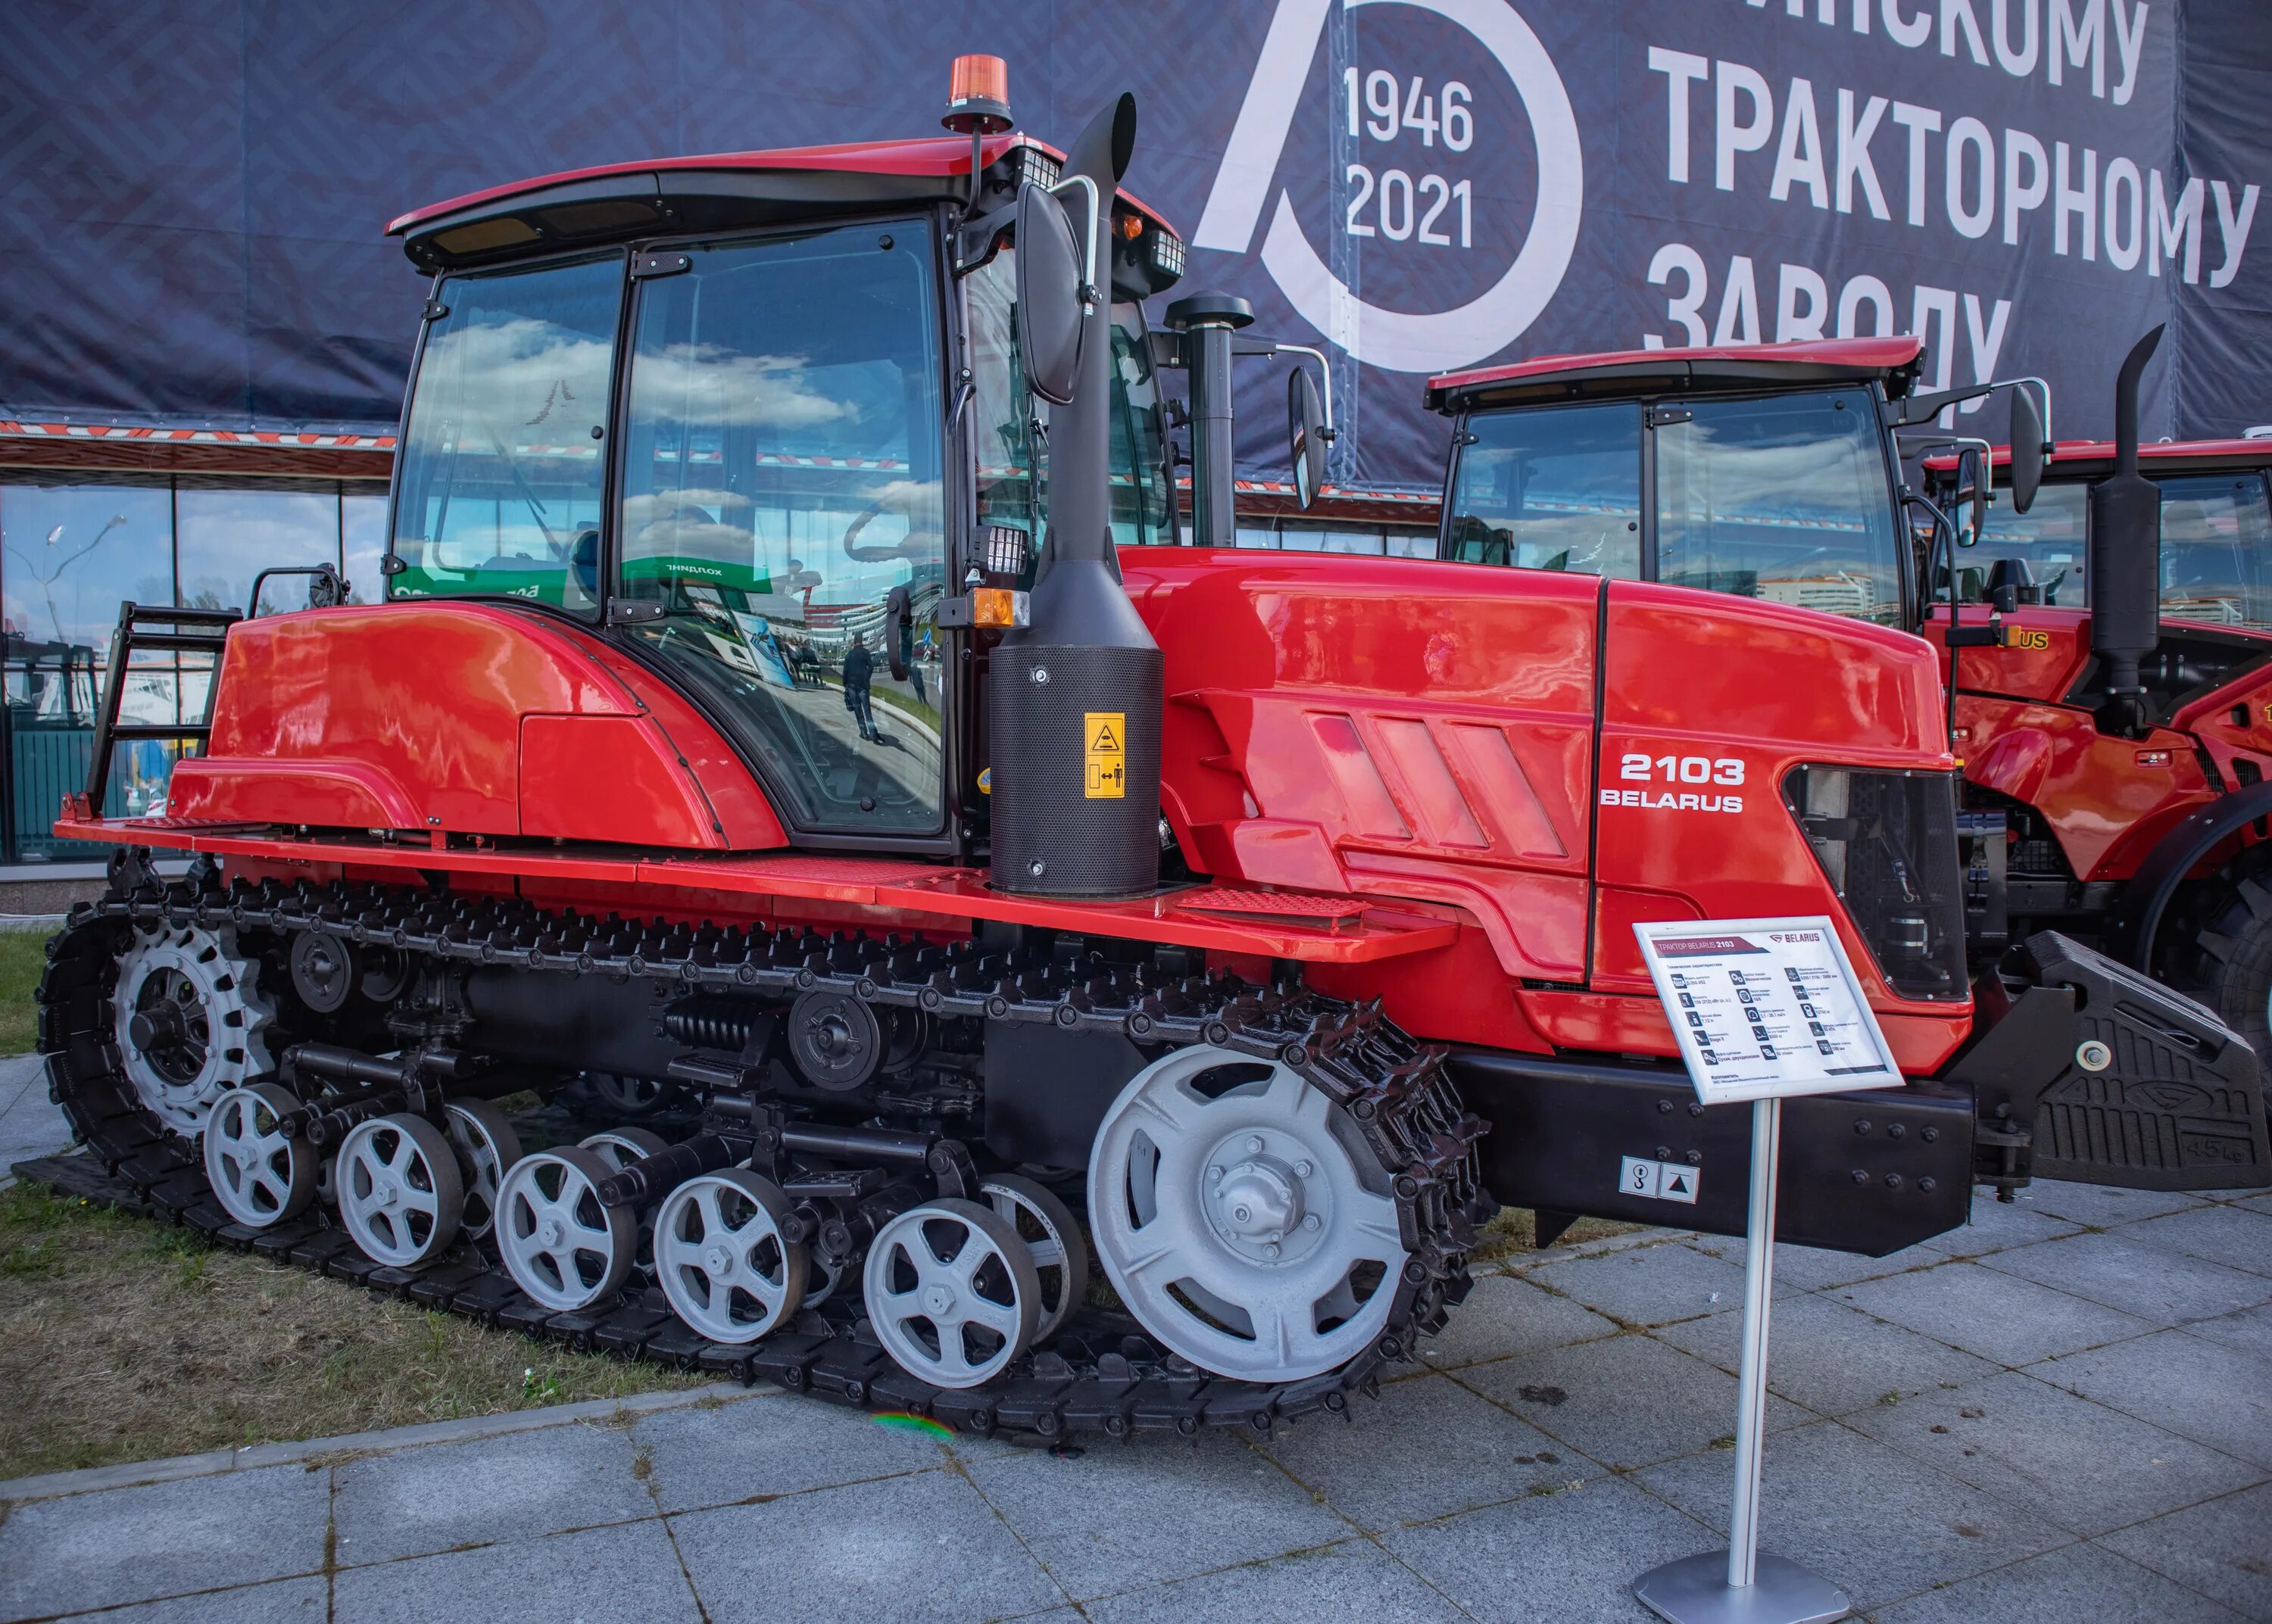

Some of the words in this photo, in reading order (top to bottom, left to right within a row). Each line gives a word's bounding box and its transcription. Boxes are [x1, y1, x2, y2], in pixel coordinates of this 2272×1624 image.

[1344, 67, 1474, 152] 1946
[1648, 46, 2260, 288] ТРАКТОРНОМУ
[1346, 164, 1471, 248] 2021
[1621, 754, 1745, 785] 2103
[1600, 789, 1743, 813] BELARUS
[1659, 943, 1687, 951] ТРАКТОР
[1688, 941, 1716, 950] BELARUS
[1785, 933, 1820, 943] BELARUS
